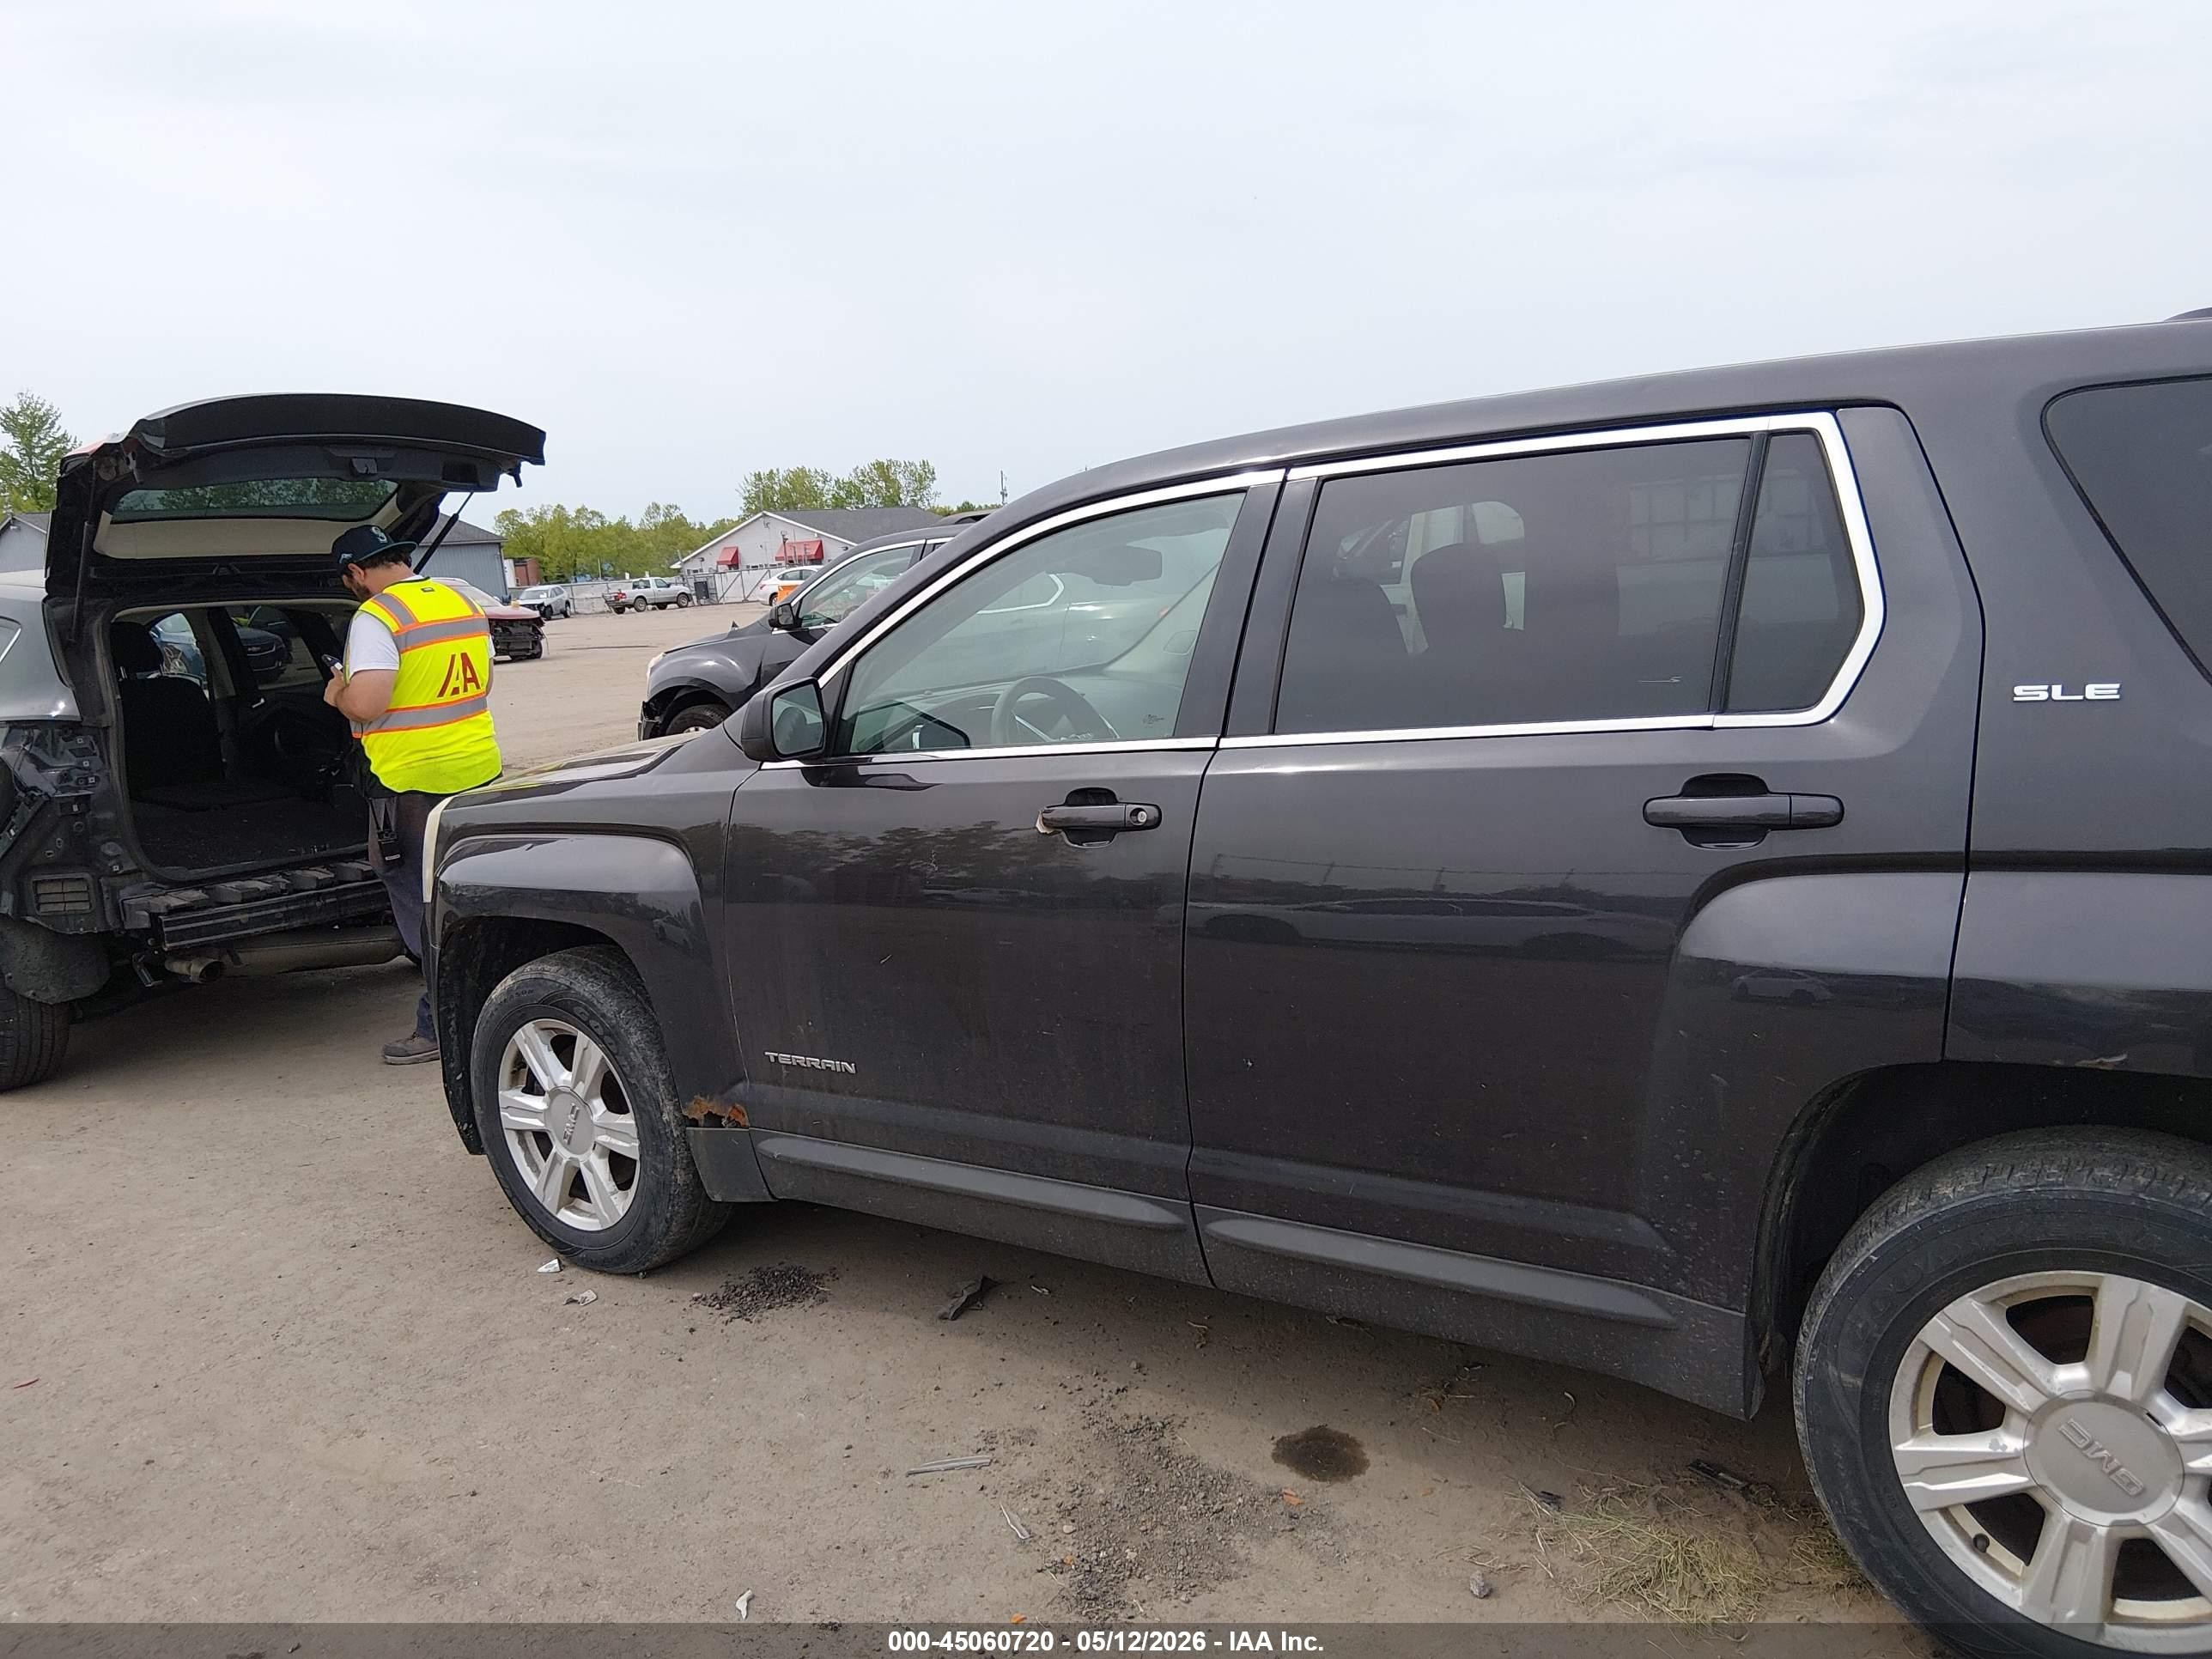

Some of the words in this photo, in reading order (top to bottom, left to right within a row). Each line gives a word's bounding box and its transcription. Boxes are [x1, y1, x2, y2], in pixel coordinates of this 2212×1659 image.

[2012, 683, 2122, 702] SLE
[763, 1051, 857, 1075] TERRAIN
[562, 1102, 580, 1146] GMC
[2057, 1418, 2145, 1497] GMC
